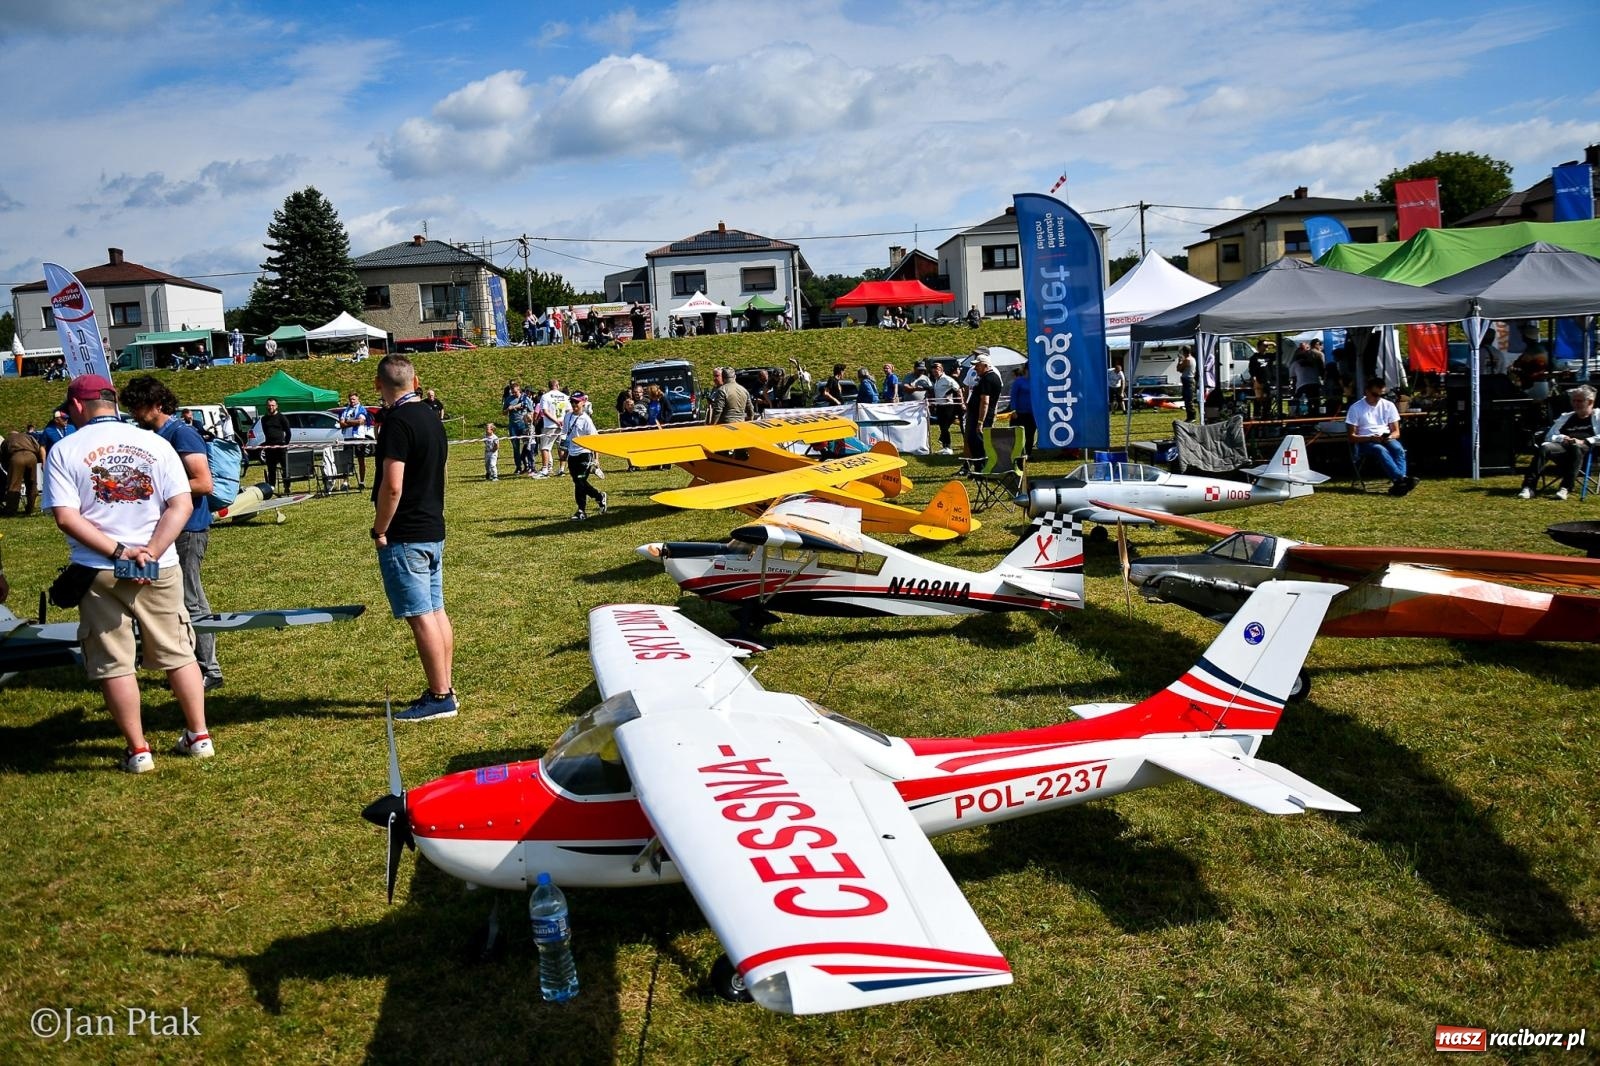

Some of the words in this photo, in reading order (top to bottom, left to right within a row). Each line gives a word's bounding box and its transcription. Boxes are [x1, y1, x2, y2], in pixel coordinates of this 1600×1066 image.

[106, 455, 135, 464] 2026
[1226, 490, 1251, 500] 1005
[951, 515, 968, 523] 28541
[887, 576, 971, 600] N198MA
[624, 634, 691, 660] SKY
[955, 764, 1108, 820] POL-2237
